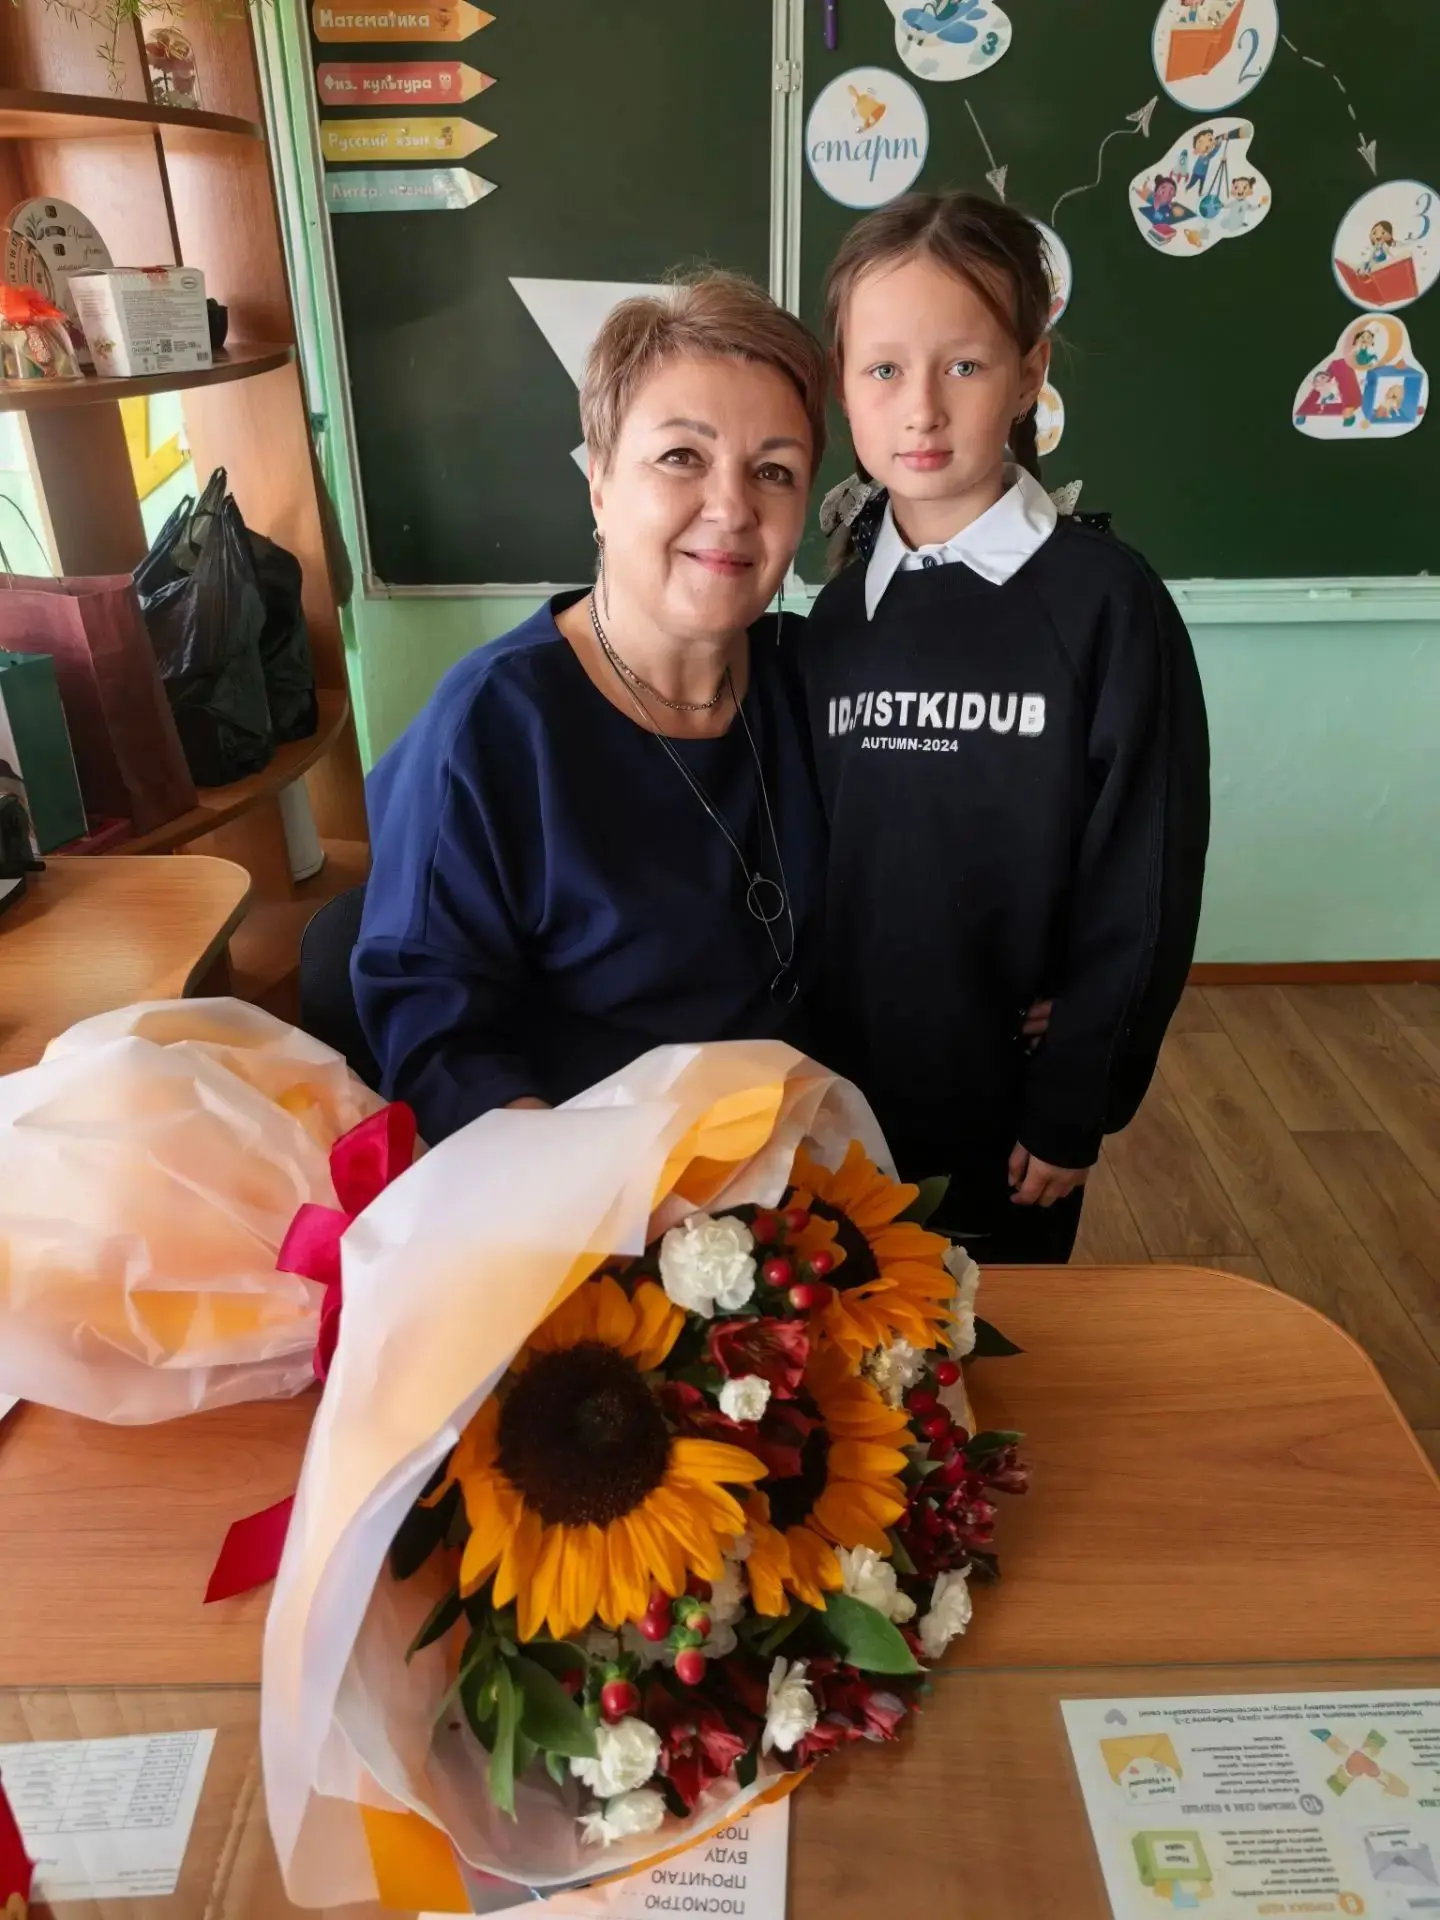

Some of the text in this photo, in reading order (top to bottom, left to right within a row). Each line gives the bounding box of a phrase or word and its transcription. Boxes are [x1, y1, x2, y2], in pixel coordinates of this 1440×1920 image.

[319, 9, 430, 28] Математика
[981, 31, 999, 56] 3
[1236, 27, 1264, 84] 2
[324, 74, 433, 93] Физ. культура
[328, 132, 430, 151] Русский язык
[811, 135, 922, 182] старт
[331, 183, 383, 199] Литер.
[1403, 192, 1433, 241] 3
[860, 736, 959, 752] AUTUMN-2024
[713, 1827, 749, 1841] ПОЗ
[704, 1848, 748, 1865] БУДУ
[651, 1870, 747, 1889] ПРОЧИТАЮ
[644, 1895, 746, 1915] ПОСМОТРЮ
